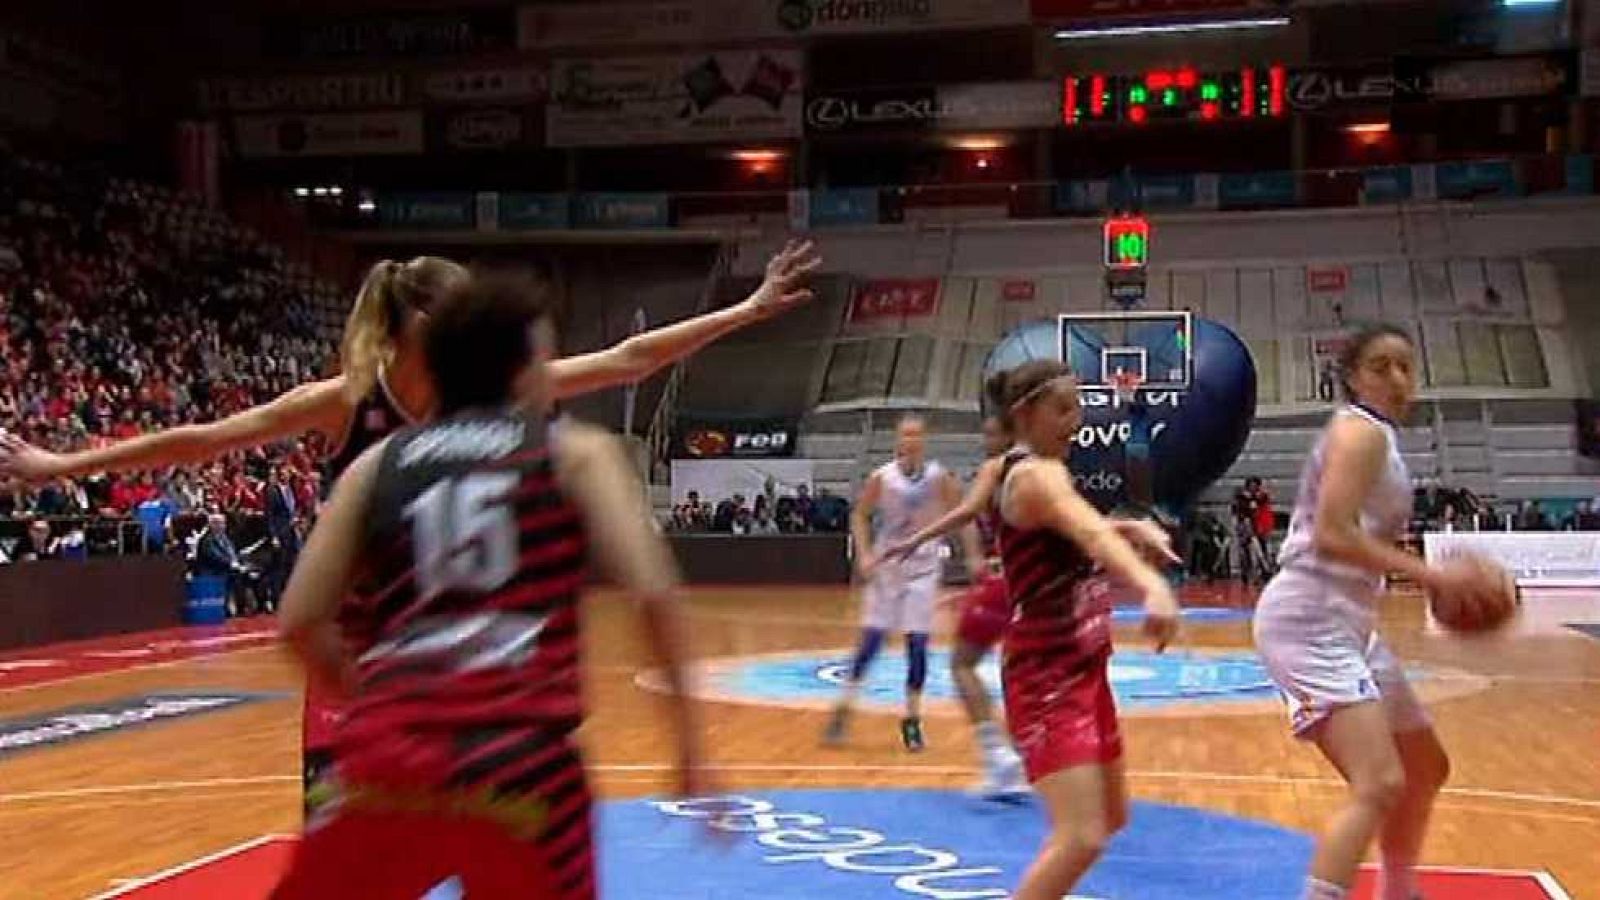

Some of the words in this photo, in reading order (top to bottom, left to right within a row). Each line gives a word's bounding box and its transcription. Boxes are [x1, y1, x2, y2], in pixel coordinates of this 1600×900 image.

[1333, 75, 1444, 98] LEXU
[852, 99, 956, 121] LEXU
[401, 472, 521, 592] 15
